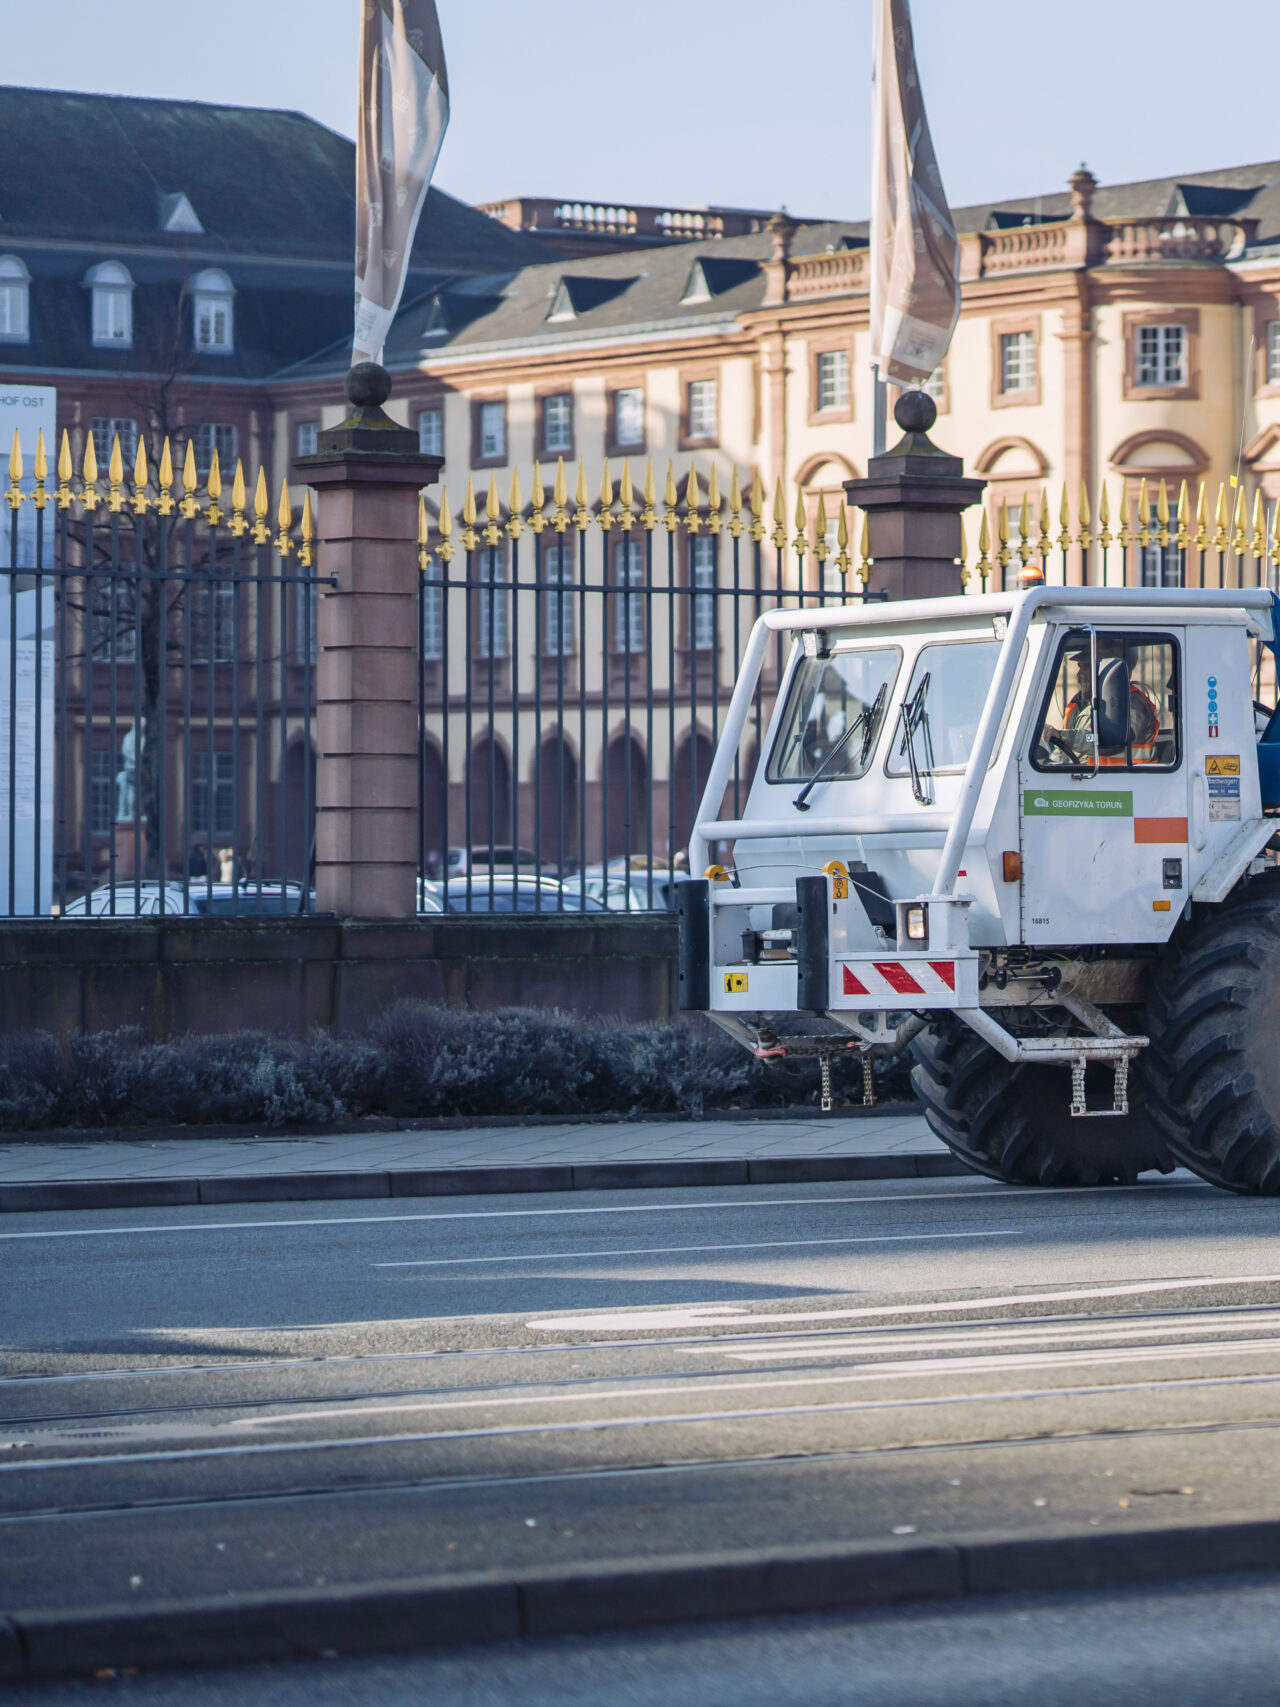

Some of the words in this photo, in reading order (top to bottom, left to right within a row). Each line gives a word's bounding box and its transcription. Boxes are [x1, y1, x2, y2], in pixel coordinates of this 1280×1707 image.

[23, 396, 45, 408] OST
[1052, 800, 1095, 809] GEOFIZYKA
[1096, 800, 1123, 809] TORUŃ
